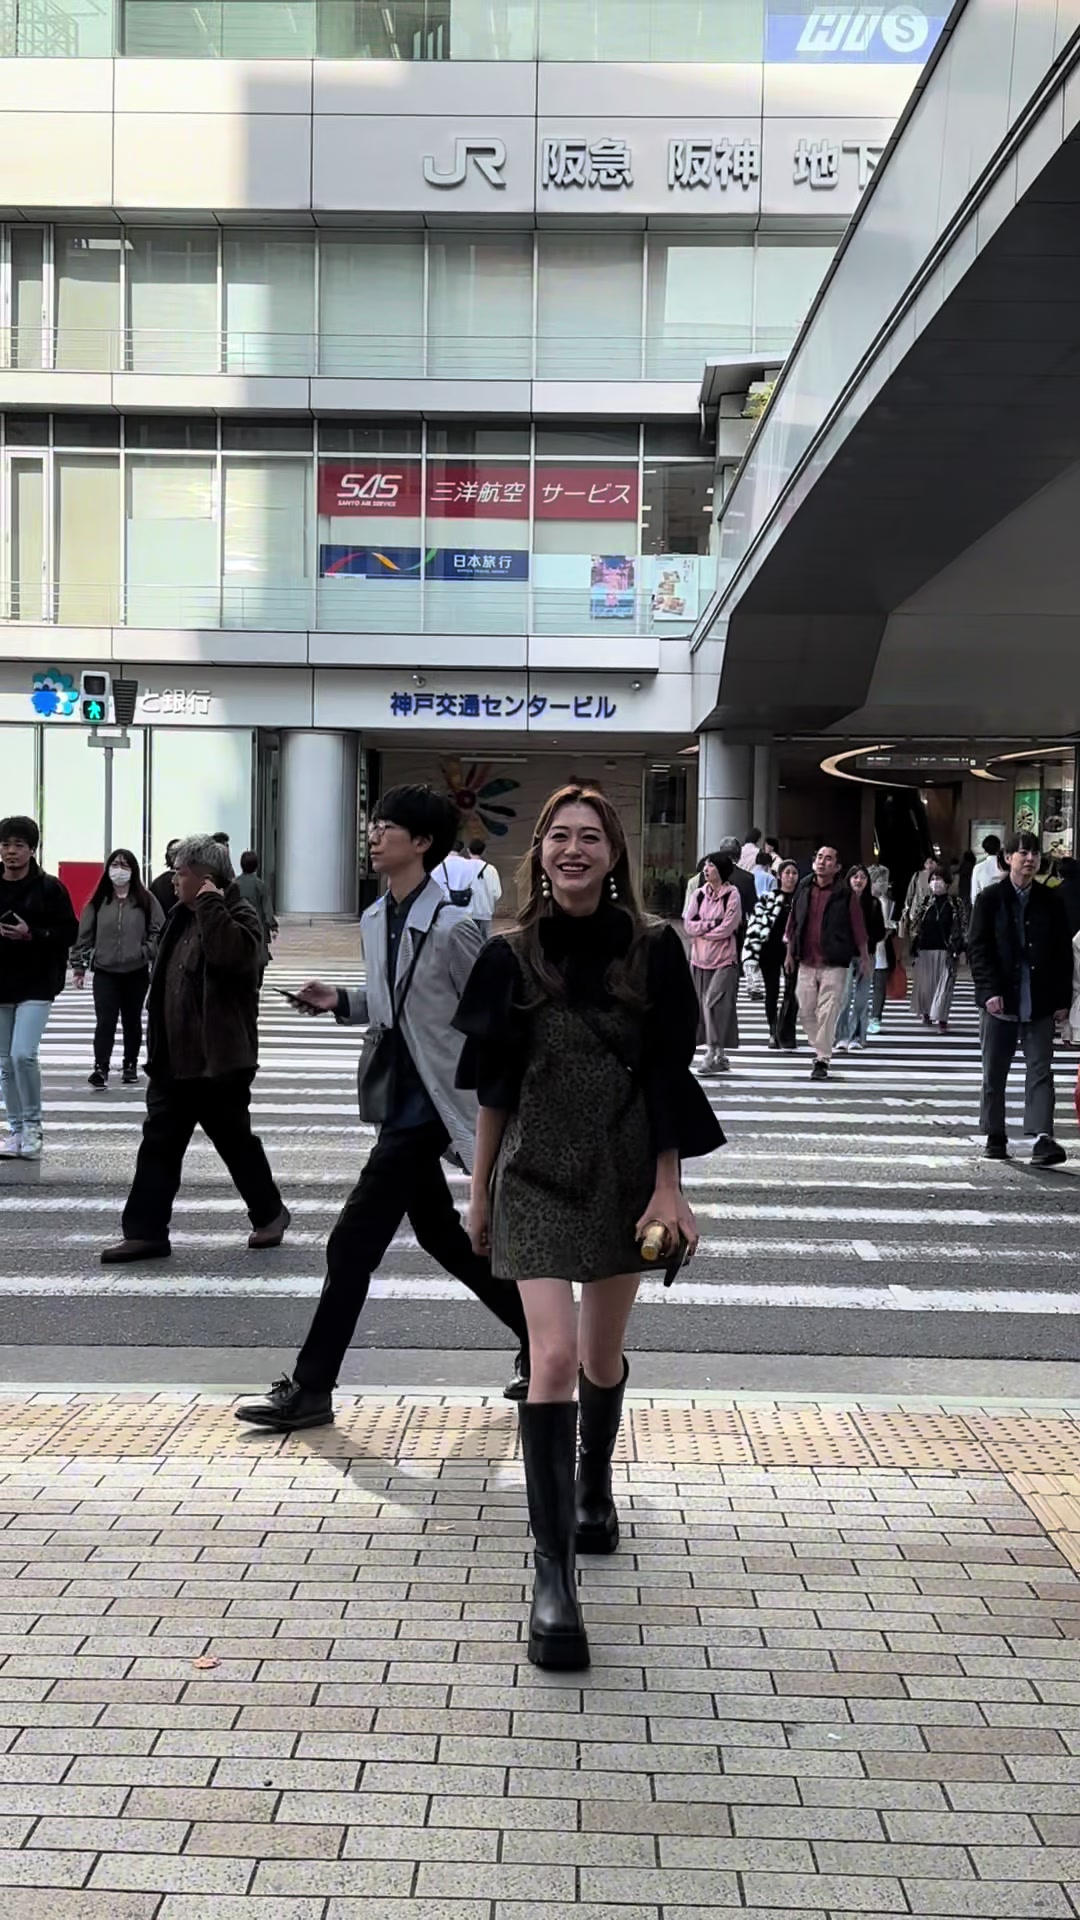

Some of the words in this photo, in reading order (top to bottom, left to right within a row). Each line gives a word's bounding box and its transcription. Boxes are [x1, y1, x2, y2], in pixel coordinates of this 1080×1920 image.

[423, 137, 507, 190] JR
[542, 137, 634, 190] 阪急
[667, 137, 760, 191] 阪神
[793, 138, 886, 190] 地下
[336, 473, 403, 498] SAS
[430, 481, 526, 503] 三洋航空
[541, 483, 631, 505] サービス
[453, 554, 513, 569] 日本旅行
[140, 688, 212, 715] と銀行
[390, 691, 617, 719] 神戸交通センタービル
